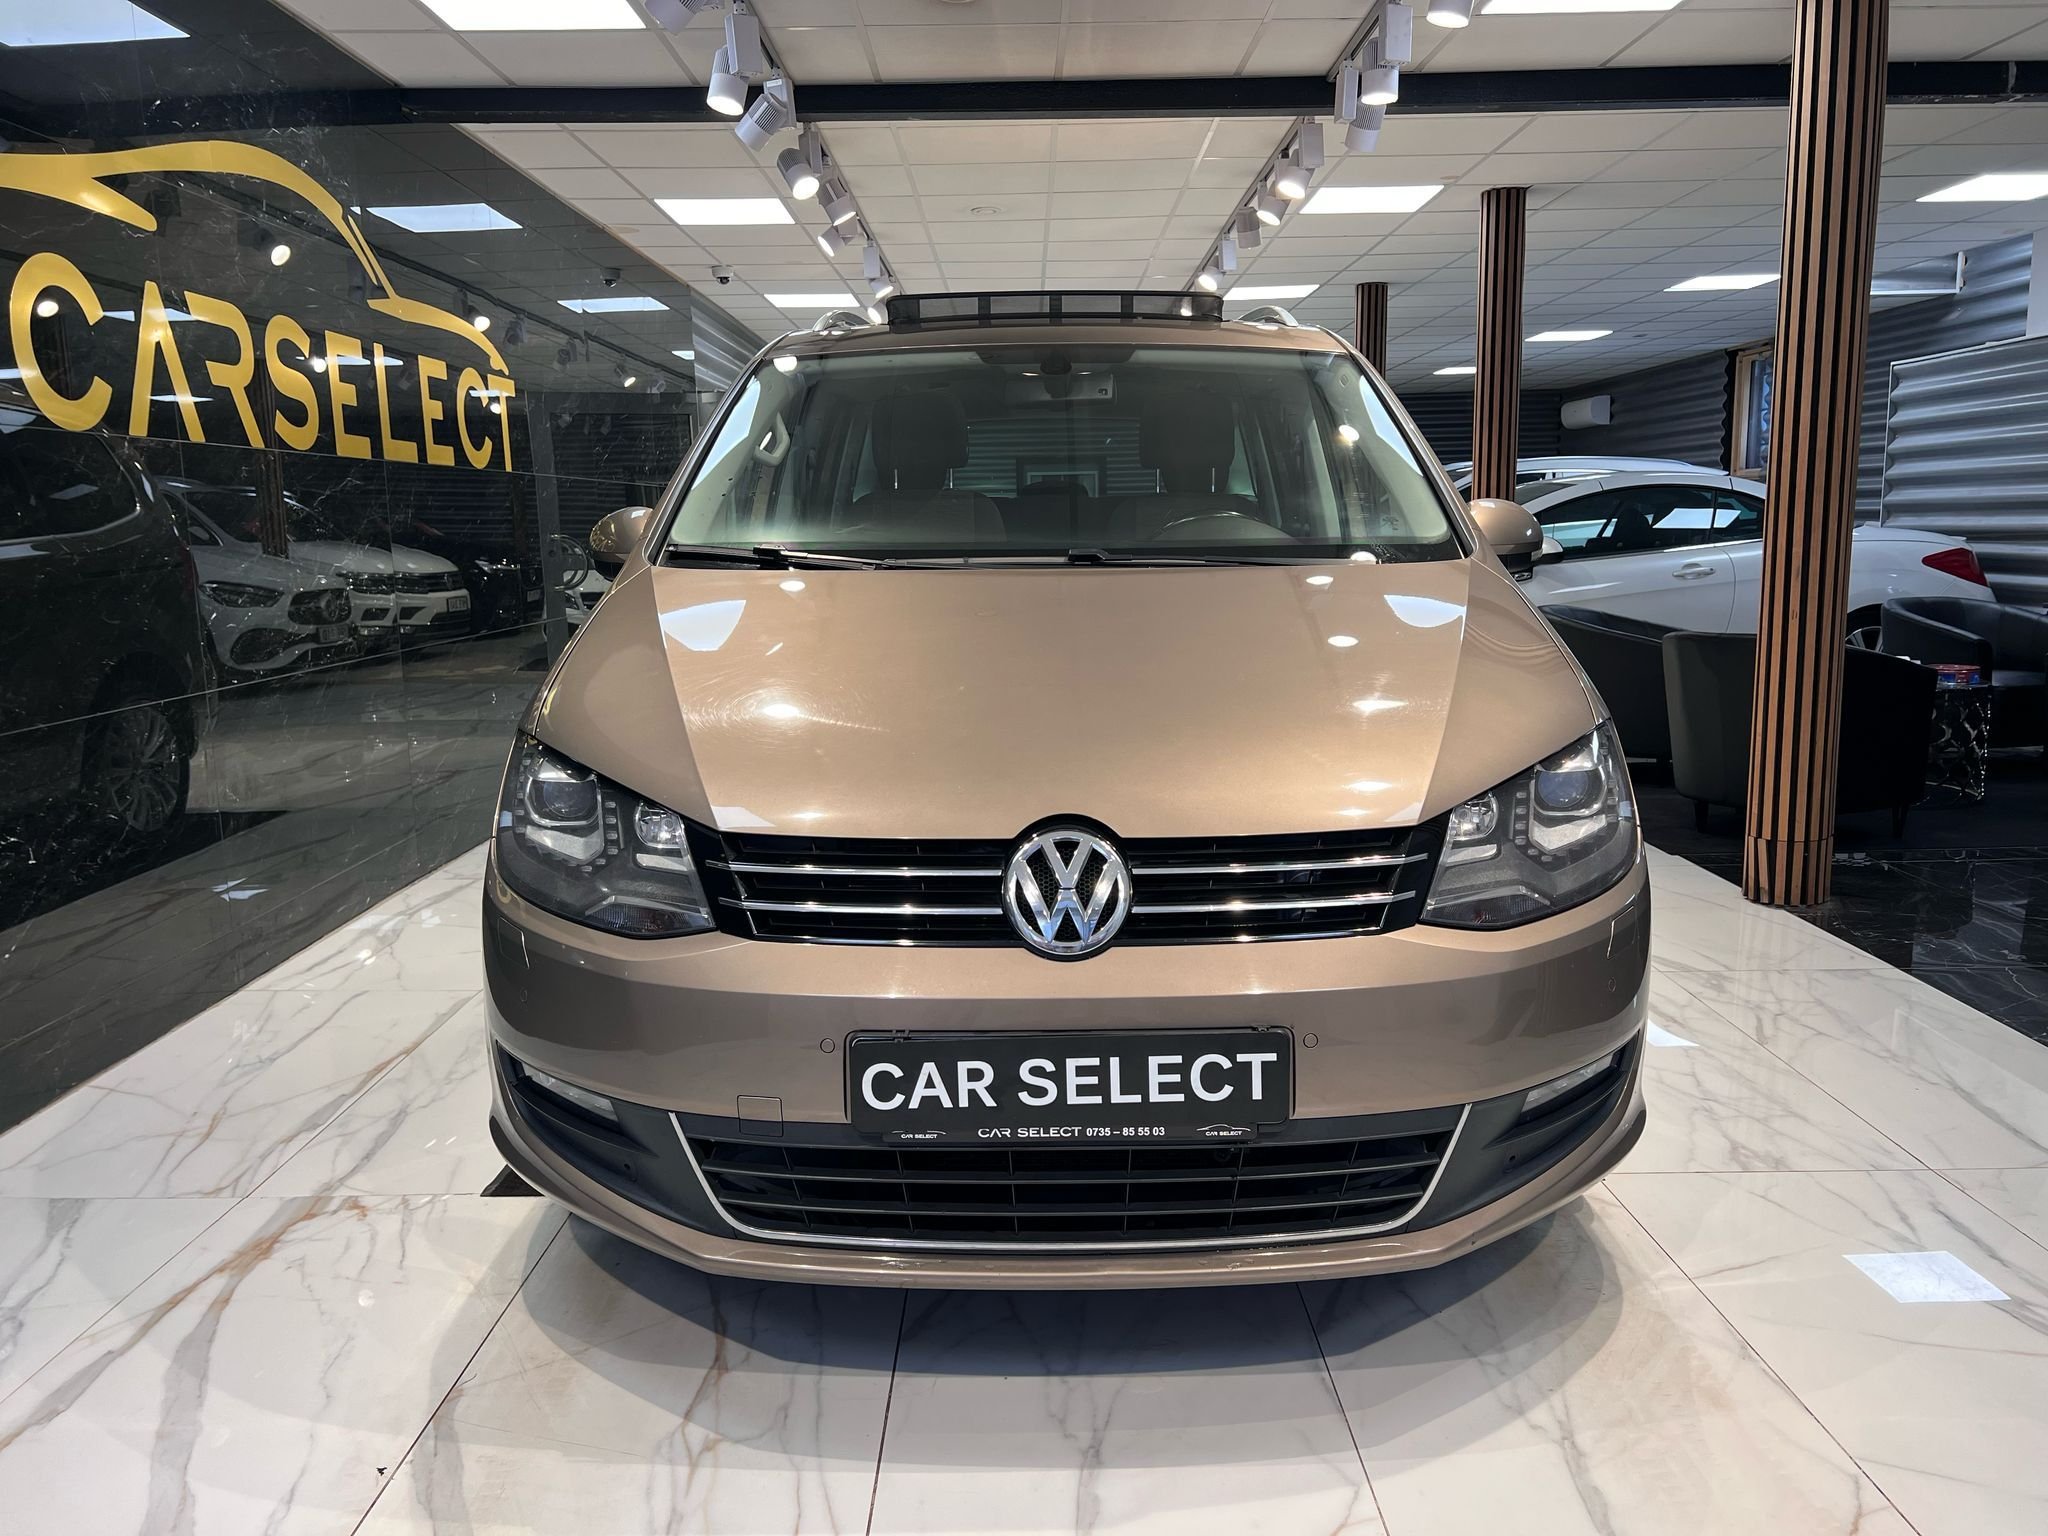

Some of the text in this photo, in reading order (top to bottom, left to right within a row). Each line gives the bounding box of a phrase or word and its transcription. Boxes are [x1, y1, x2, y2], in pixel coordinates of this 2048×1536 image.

[861, 1053, 1278, 1111] CAR SELECT
[977, 1127, 1012, 1138] CAR
[1017, 1126, 1082, 1138] SELECT
[1086, 1127, 1112, 1137] 0735
[1122, 1126, 1136, 1137] 85
[1137, 1126, 1151, 1136] 55
[1152, 1126, 1166, 1136] 03
